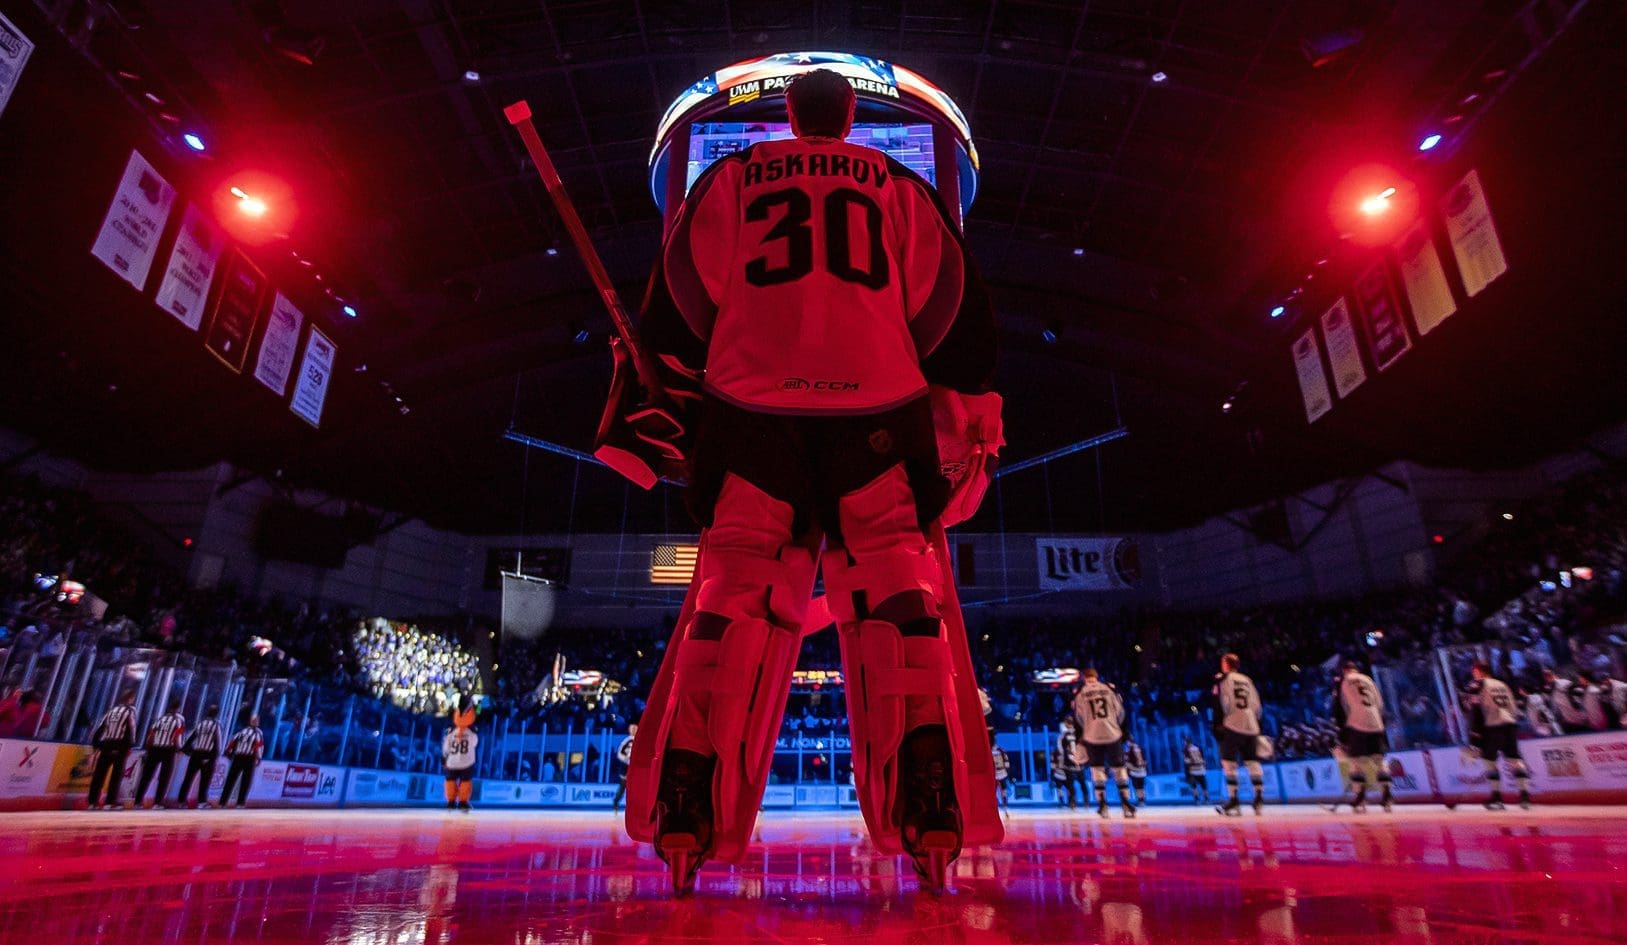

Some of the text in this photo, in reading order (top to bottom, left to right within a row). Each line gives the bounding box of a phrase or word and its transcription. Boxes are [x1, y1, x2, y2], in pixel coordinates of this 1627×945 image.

[730, 81, 759, 97] UWM
[847, 78, 899, 98] ARENA
[745, 154, 886, 188] ASKAROV
[745, 187, 890, 290] 30
[813, 381, 859, 390] CCM
[1042, 545, 1100, 581] Lite
[1088, 696, 1108, 720] 13
[1234, 687, 1249, 709] 5
[451, 739, 469, 754] 98
